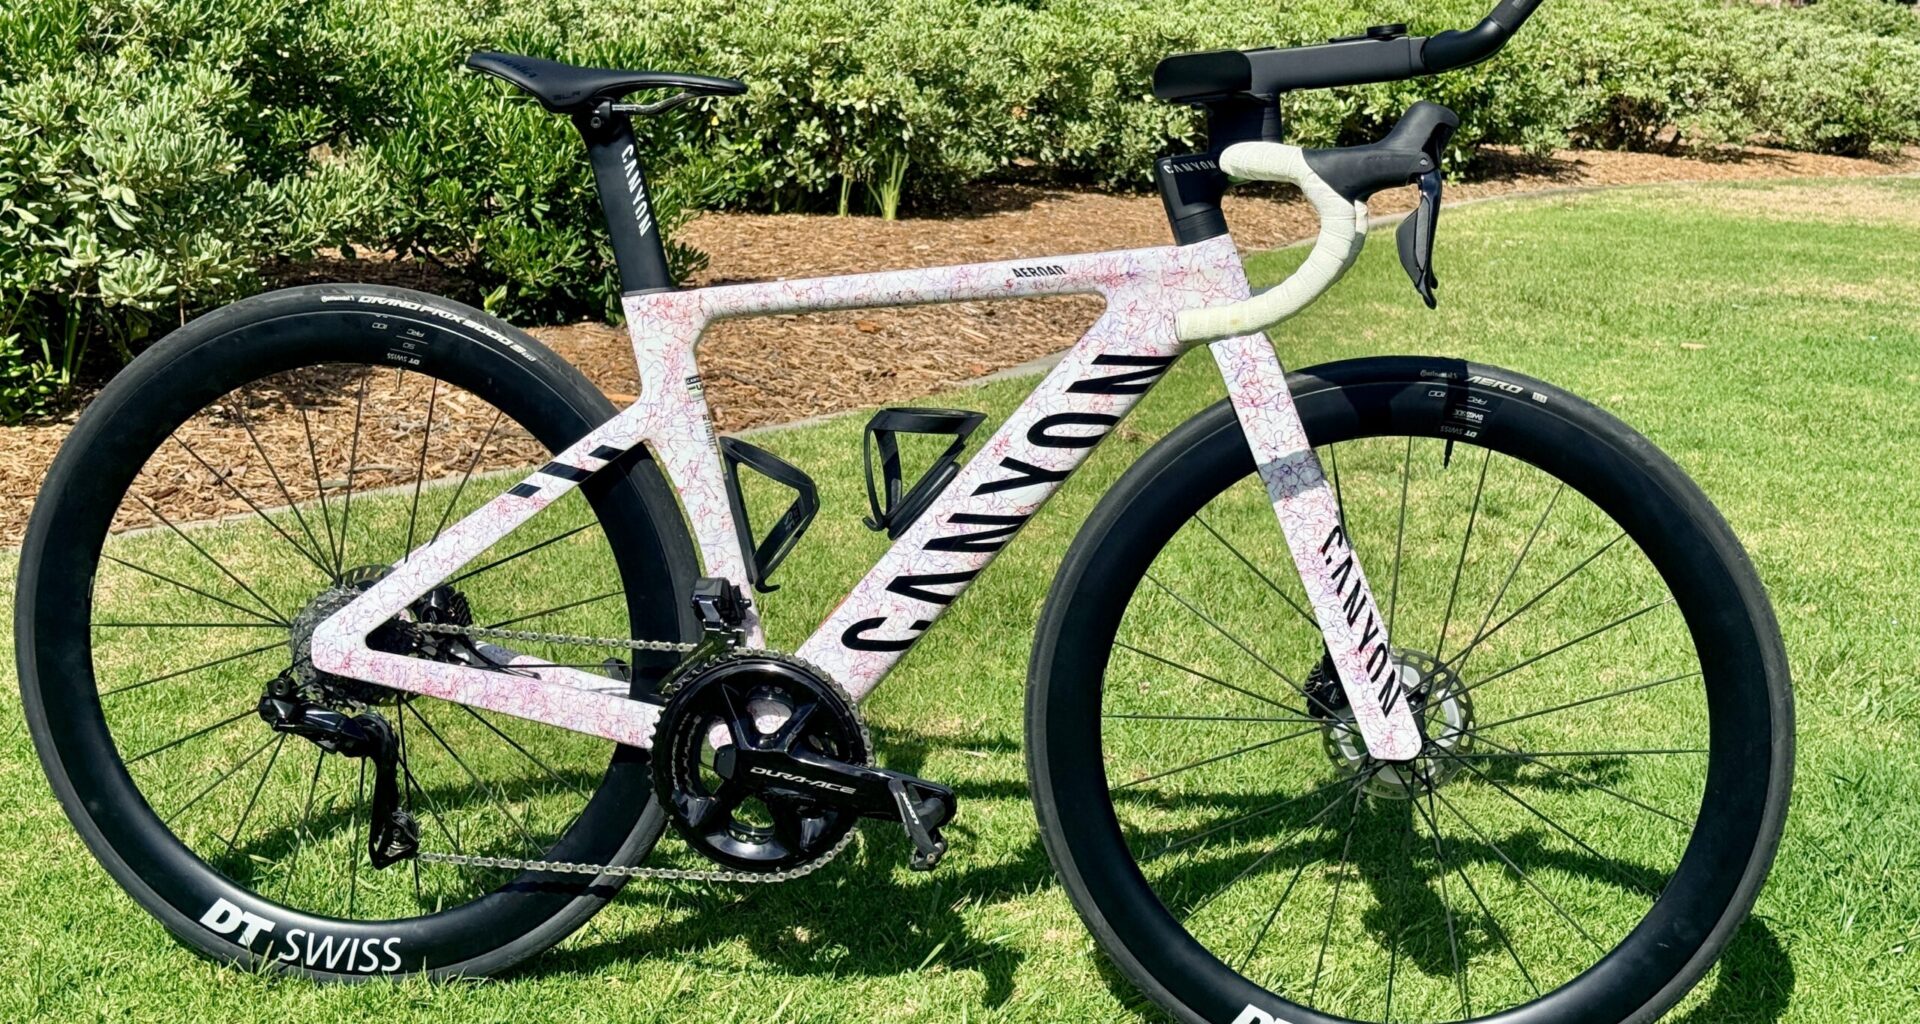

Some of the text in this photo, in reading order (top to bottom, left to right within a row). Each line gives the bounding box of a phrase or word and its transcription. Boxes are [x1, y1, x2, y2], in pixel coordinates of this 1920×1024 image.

[621, 144, 652, 237] CANYON
[1163, 160, 1217, 174] CANYON
[1011, 264, 1067, 278] AEROAD
[1465, 375, 1524, 394] AERO
[841, 354, 1179, 652] CANYON
[1321, 525, 1401, 718] CANYON
[750, 766, 857, 795] DURA-ACE
[199, 897, 402, 973] DT SWISS
